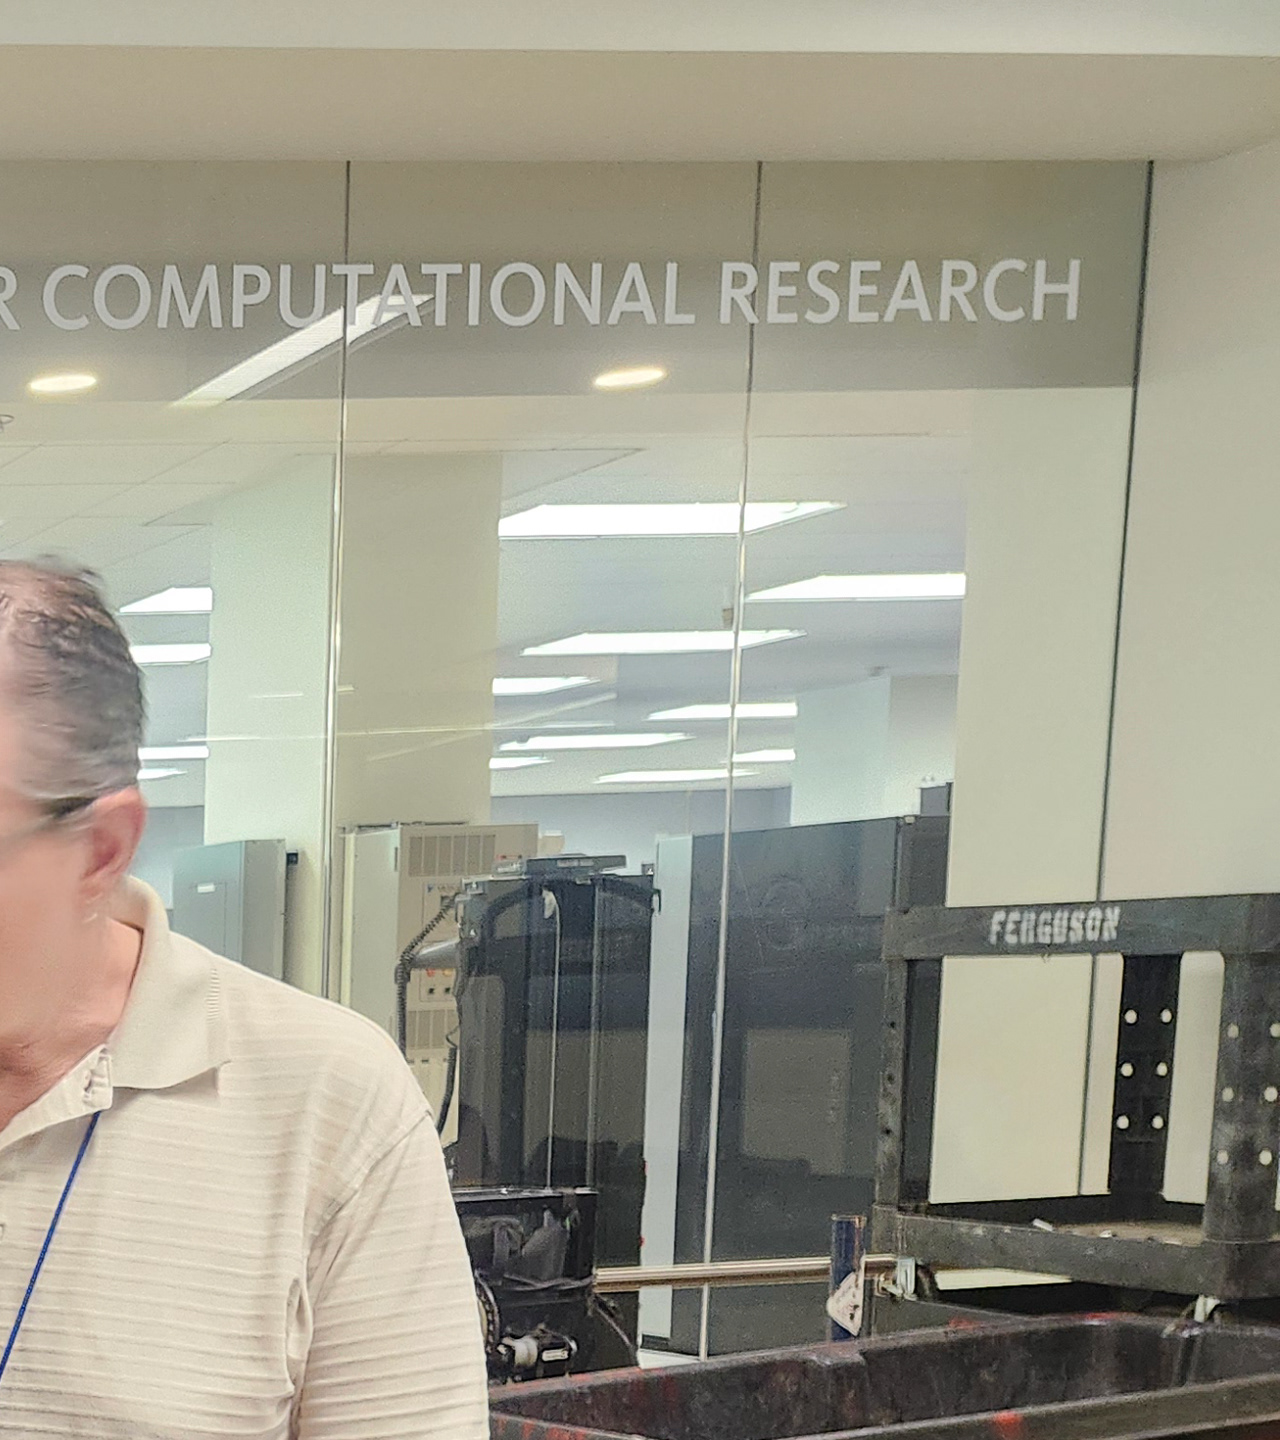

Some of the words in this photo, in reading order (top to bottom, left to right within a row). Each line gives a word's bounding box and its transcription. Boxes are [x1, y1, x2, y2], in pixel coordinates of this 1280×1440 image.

[39, 261, 700, 332] COMPUTATIONAL
[719, 257, 1082, 325] RESEARCH
[989, 906, 1122, 945] FERGUSON
